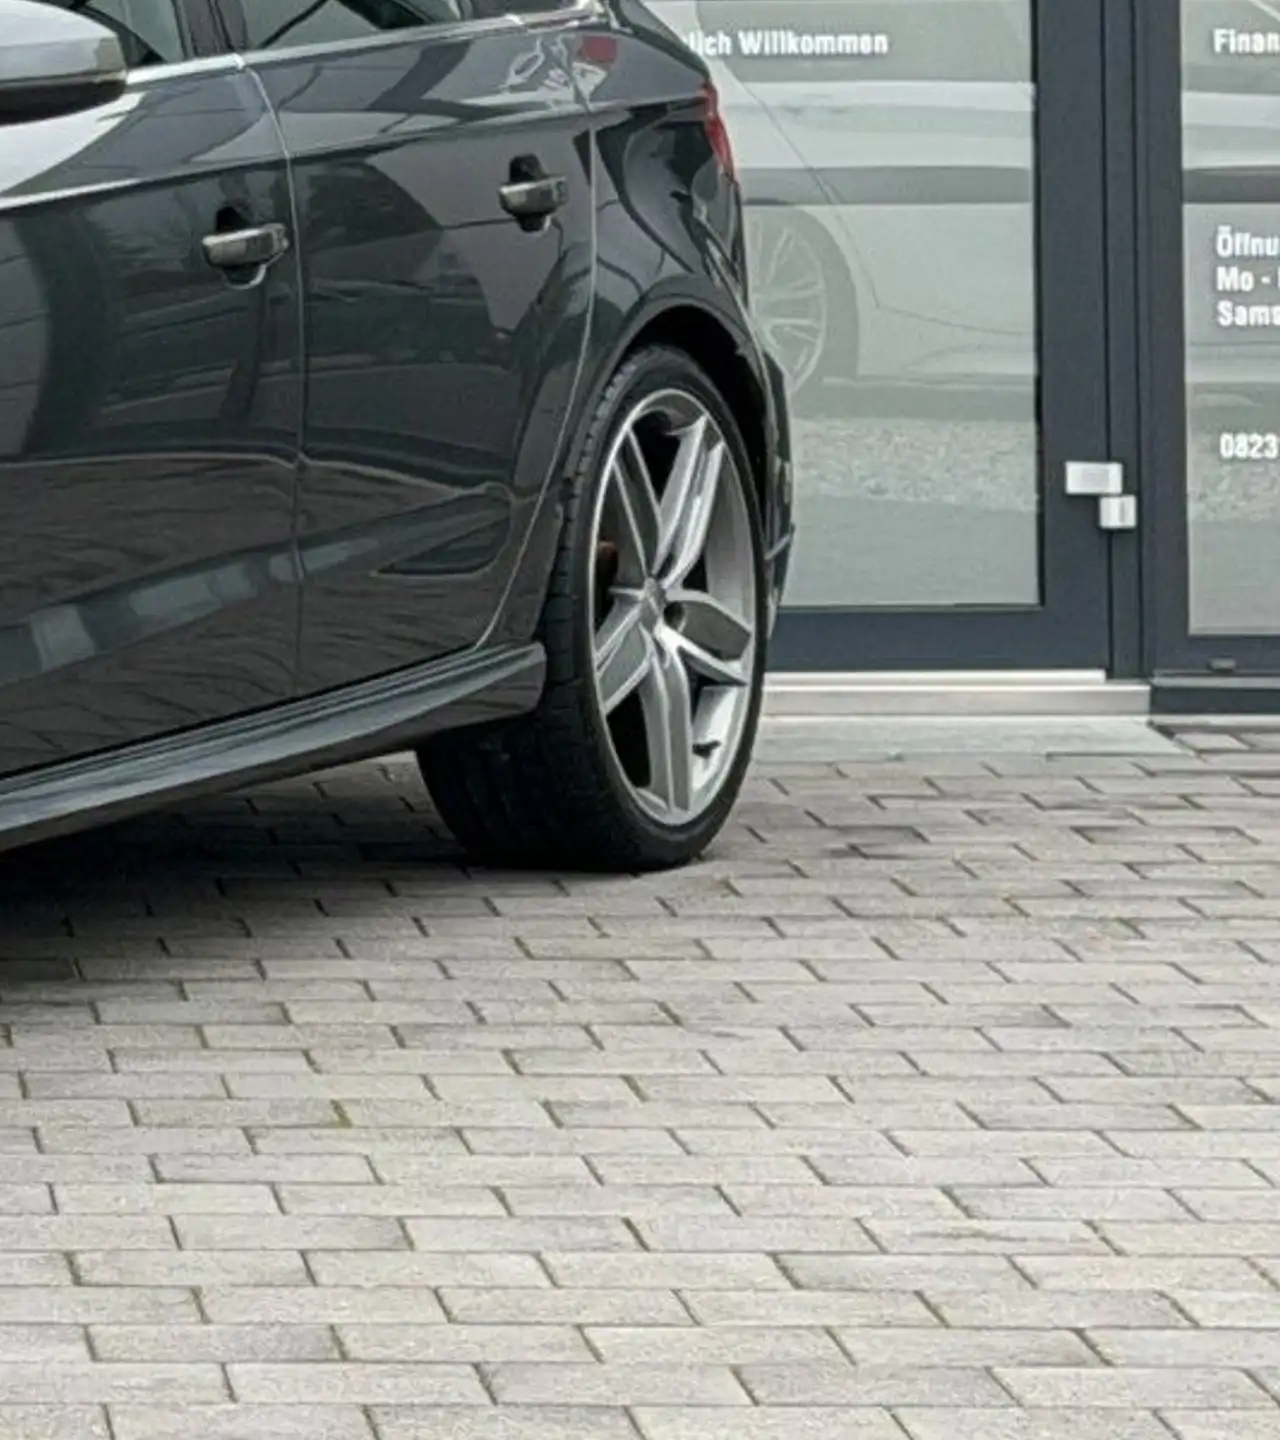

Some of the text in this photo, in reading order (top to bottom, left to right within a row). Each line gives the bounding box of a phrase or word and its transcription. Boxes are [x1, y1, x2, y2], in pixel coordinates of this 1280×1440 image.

[682, 30, 889, 56] lich Willkommen
[1213, 28, 1280, 54] Finan
[1217, 265, 1255, 292] Mo
[1220, 432, 1278, 459] 0823
